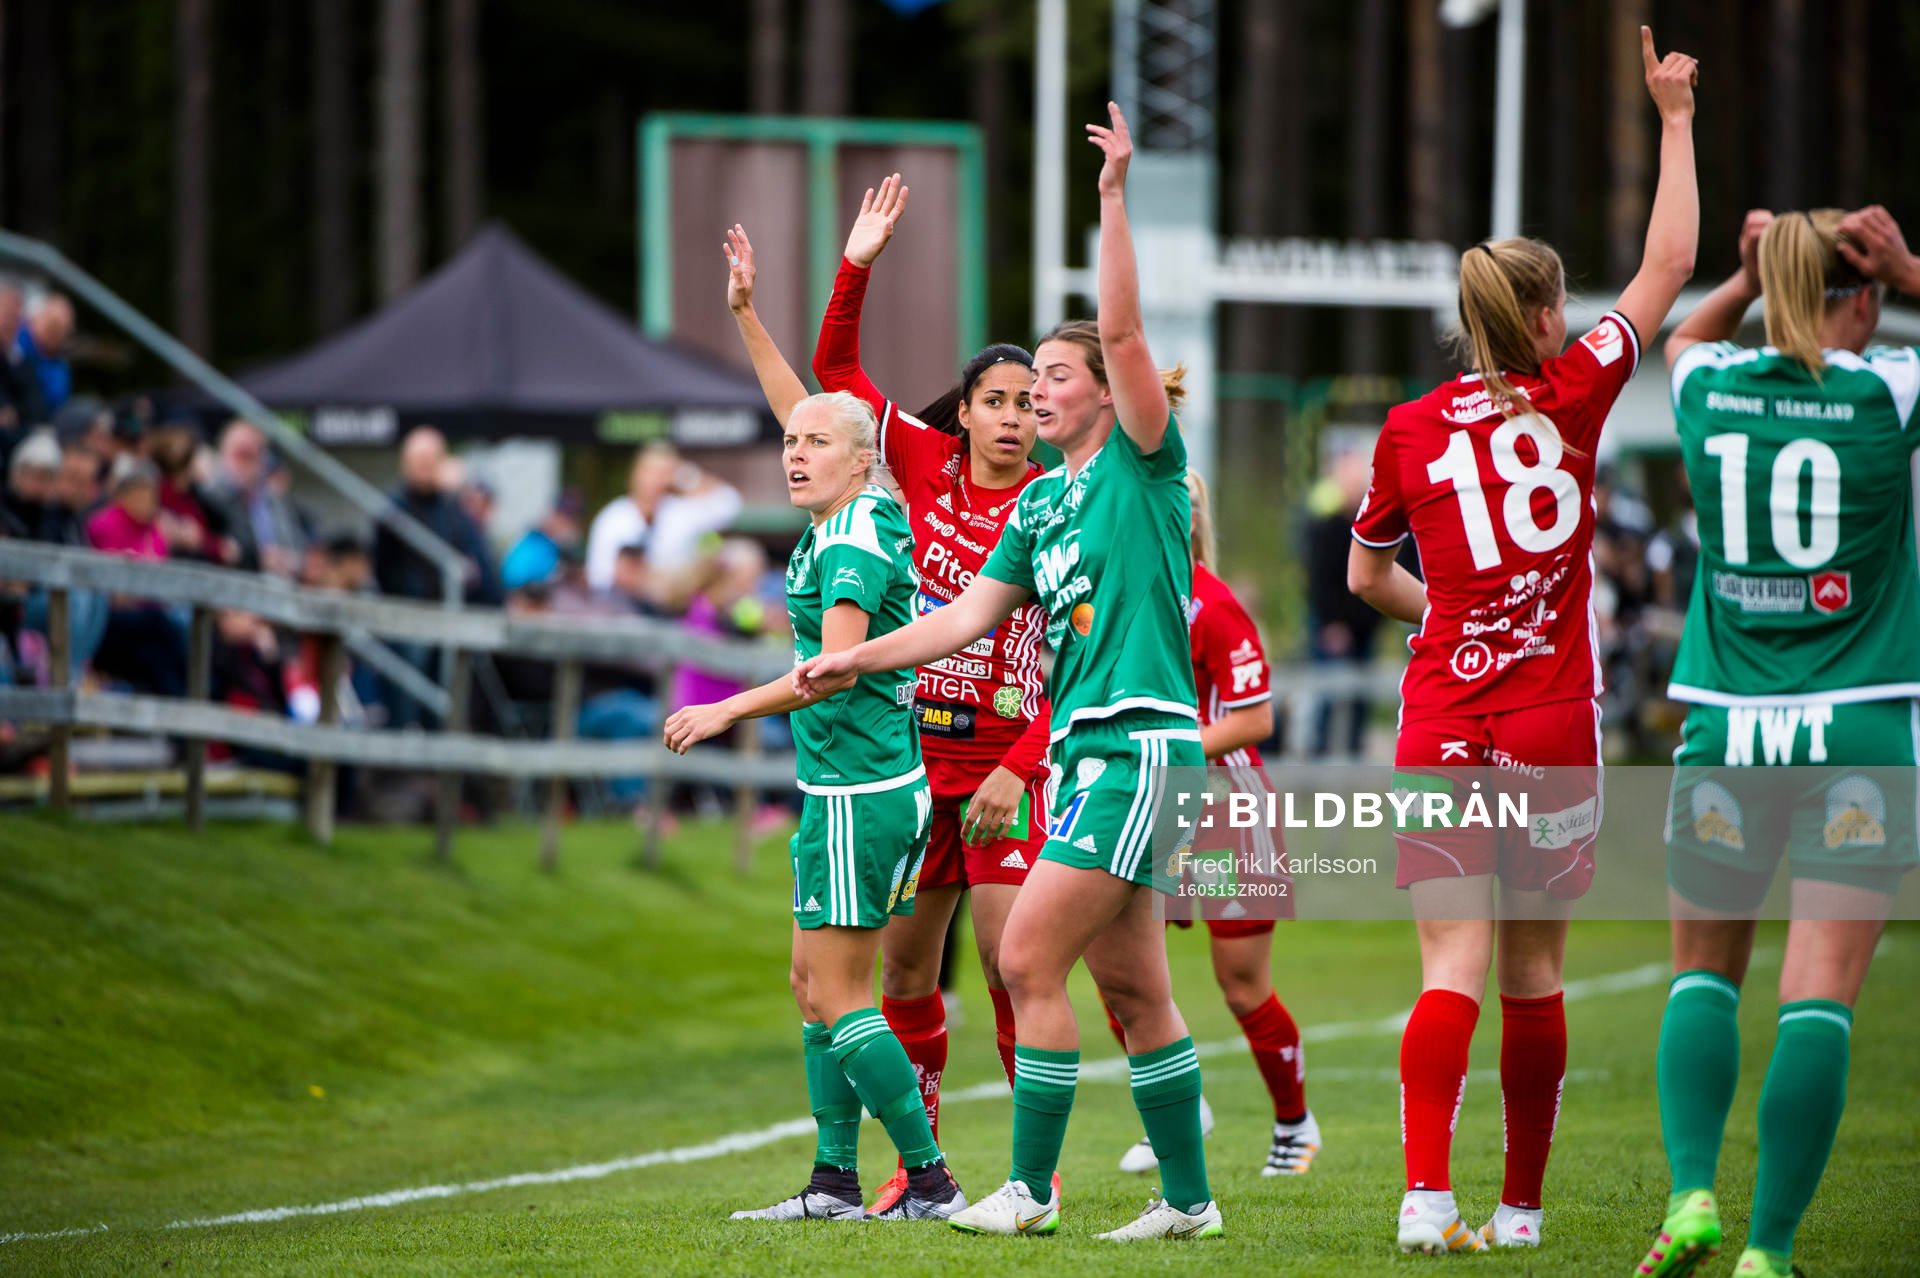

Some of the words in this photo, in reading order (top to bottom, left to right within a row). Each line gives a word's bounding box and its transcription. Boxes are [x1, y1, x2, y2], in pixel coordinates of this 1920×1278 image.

[1426, 412, 1582, 571] 18
[1704, 432, 1842, 570] 10
[1725, 704, 1833, 766] NWT
